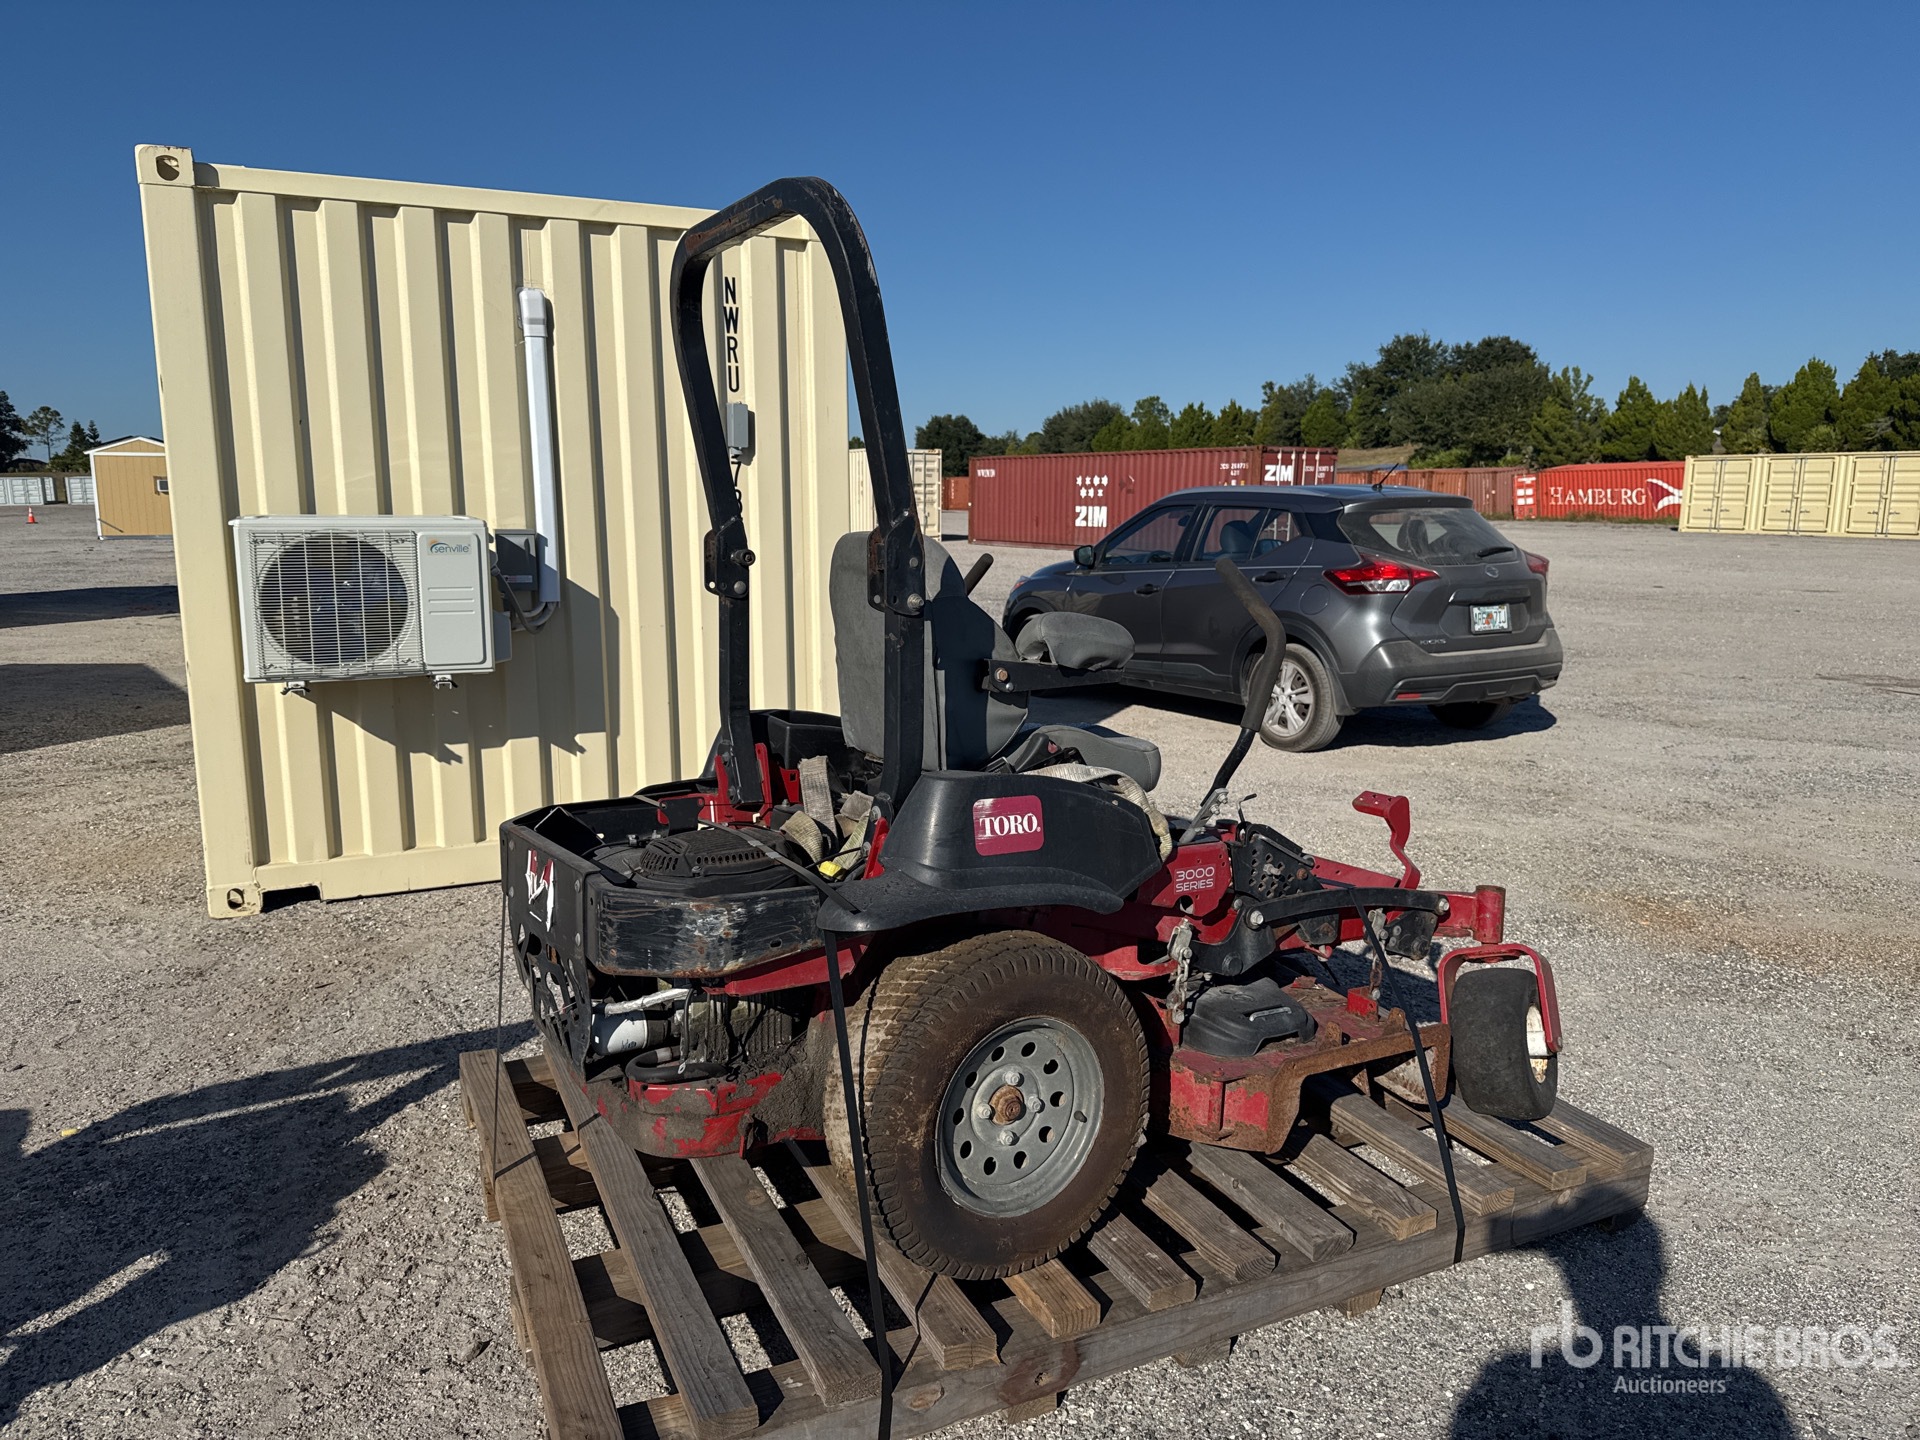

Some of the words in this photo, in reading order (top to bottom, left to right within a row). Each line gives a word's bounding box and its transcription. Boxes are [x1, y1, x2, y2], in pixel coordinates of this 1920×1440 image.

[723, 277, 740, 393] NWRU
[1264, 464, 1293, 482] ZIM
[1549, 486, 1647, 507] HAMBURG
[1075, 505, 1108, 528] ZIM
[433, 544, 470, 554] senville
[979, 813, 1038, 837] TORO
[1175, 867, 1215, 882] 3000
[1175, 878, 1214, 893] SERIES
